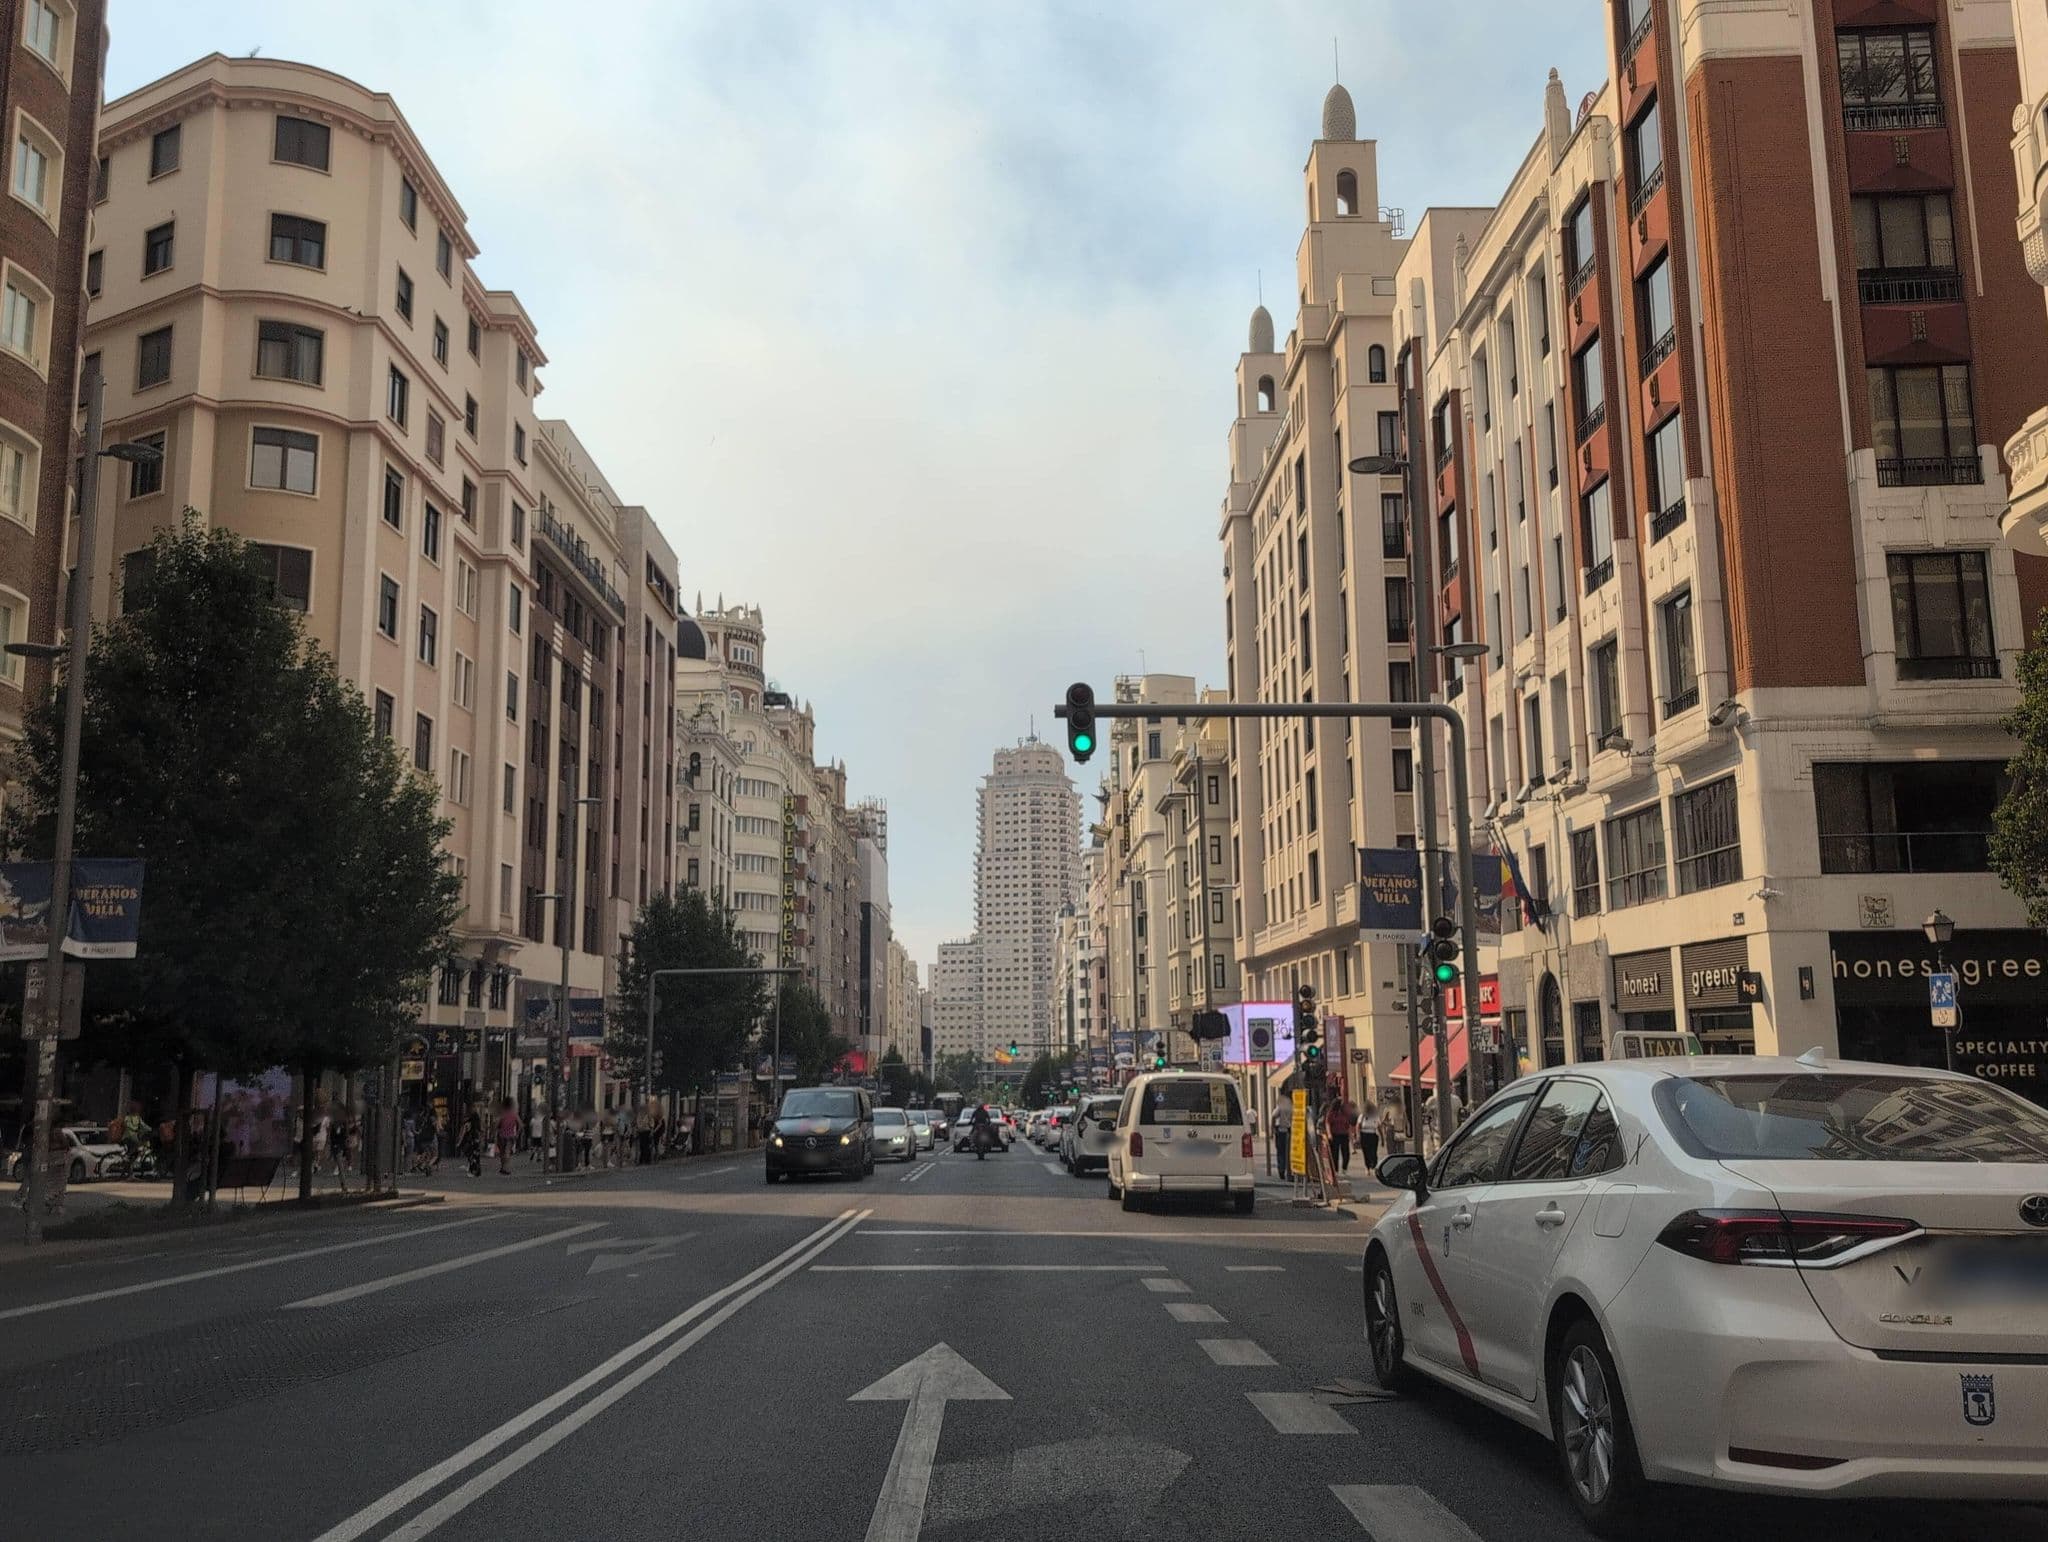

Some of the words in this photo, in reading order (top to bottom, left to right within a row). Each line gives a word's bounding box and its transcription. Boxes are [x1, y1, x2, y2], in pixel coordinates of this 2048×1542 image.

[783, 796, 795, 874] HOTEL
[1362, 876, 1418, 889] VERANOS
[1373, 891, 1410, 905] VILLA
[84, 902, 125, 916] VILLA
[783, 883, 795, 972] EMPERA
[1832, 949, 1940, 979] hones
[1962, 957, 2048, 986] gree
[1623, 970, 1660, 995] honest
[1691, 965, 1736, 996] greens
[1742, 979, 1757, 995] hg
[1645, 1040, 1685, 1057] TAXI
[1955, 1041, 2048, 1055] SPECIALTY
[1975, 1063, 2036, 1077] COFFEE
